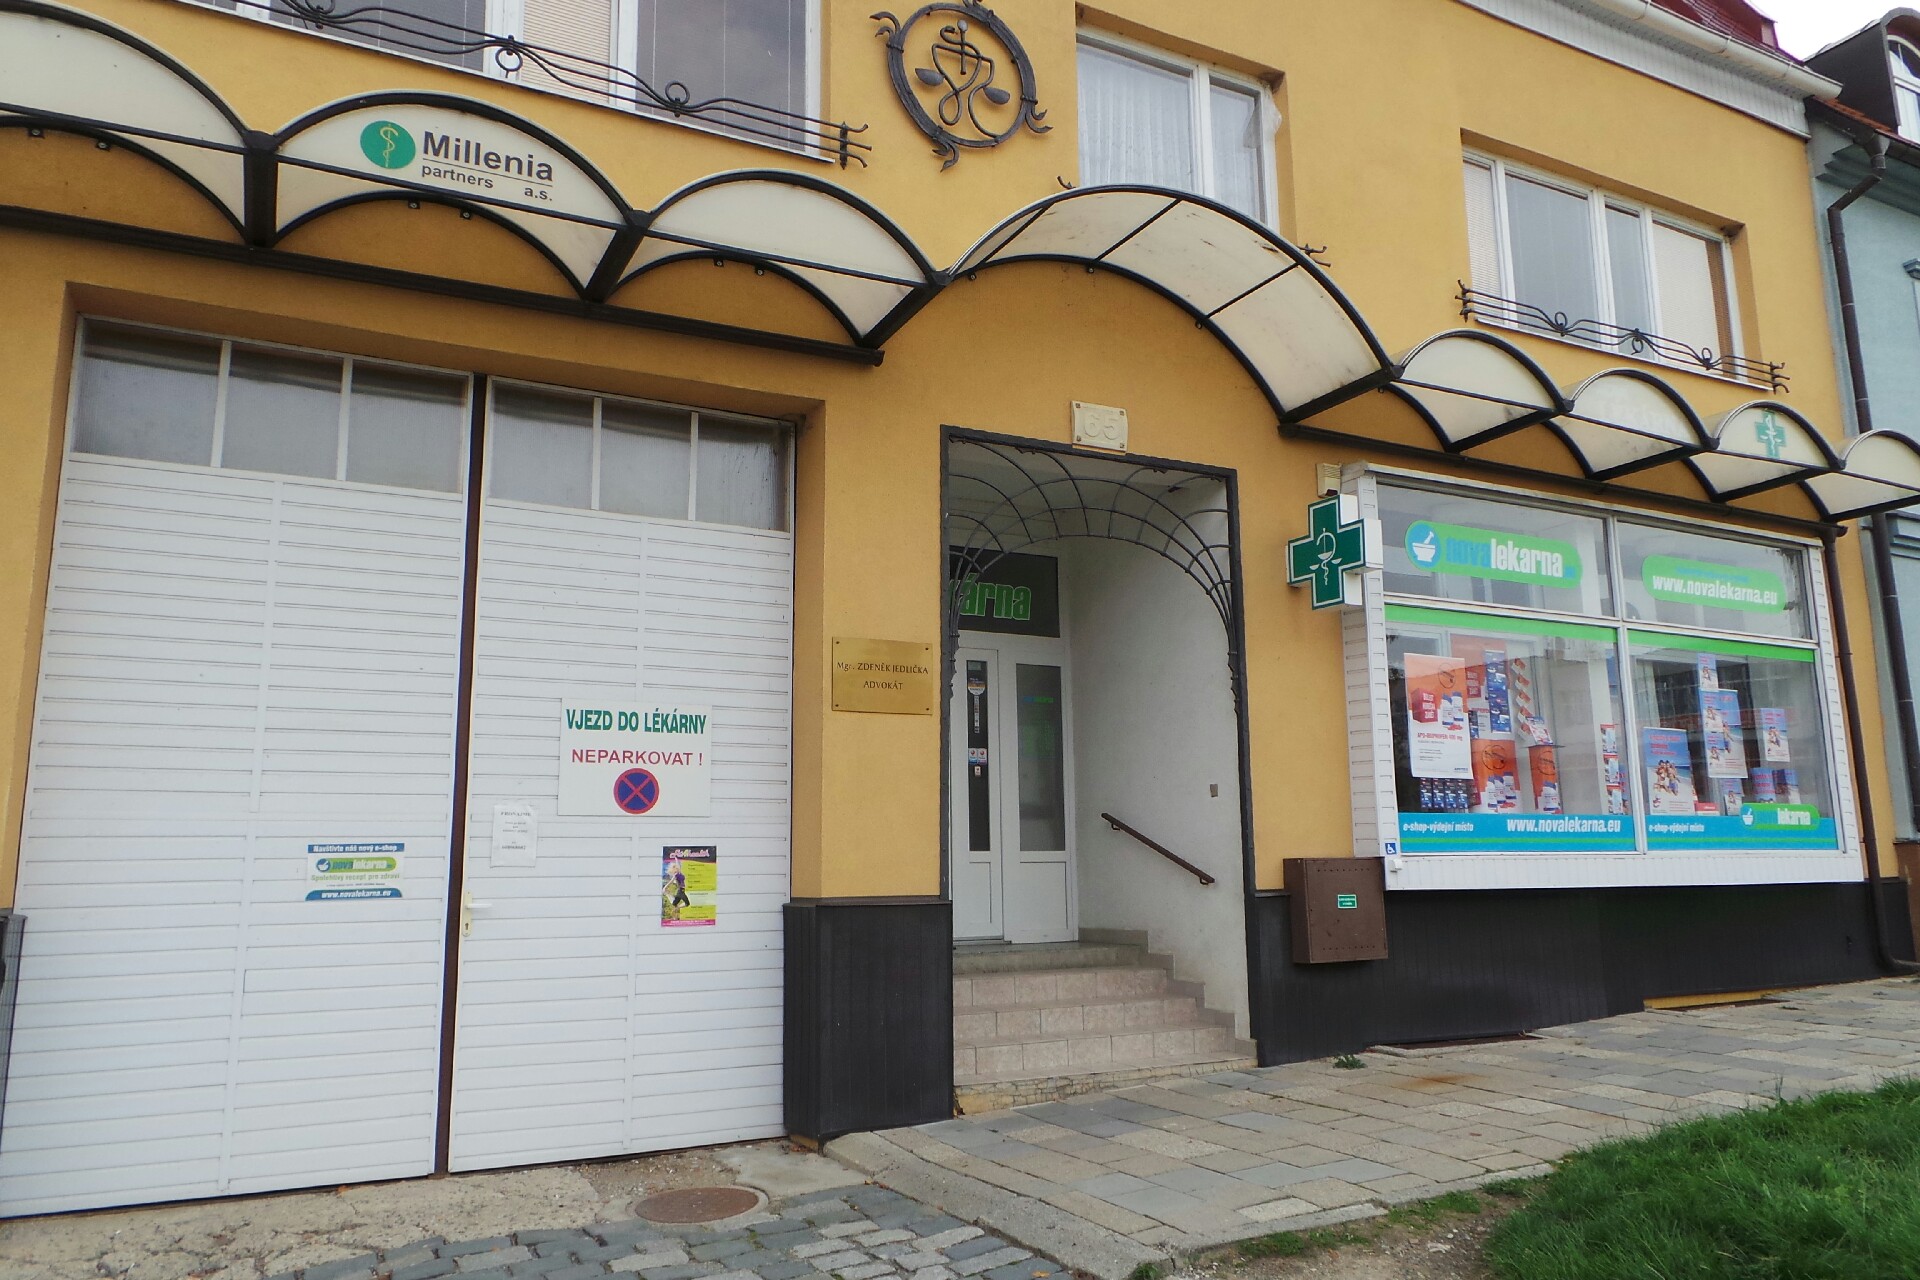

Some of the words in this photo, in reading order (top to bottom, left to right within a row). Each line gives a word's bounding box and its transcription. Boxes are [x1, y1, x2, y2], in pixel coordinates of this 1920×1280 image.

[423, 131, 553, 181] Millenia
[422, 165, 494, 188] partners
[524, 187, 553, 201] a.s.
[1084, 413, 1121, 441] 65
[1652, 575, 1778, 605] www.novalekarna.eu
[837, 662, 855, 672] Mgr.
[857, 662, 891, 672] ZDENĚK
[892, 665, 929, 674] JEDLIČKA
[863, 680, 904, 690] ADVOKÁT
[566, 708, 613, 731] VJEZD
[618, 711, 639, 732] DO
[644, 707, 707, 734] LÉKÁRNY
[572, 749, 693, 765] NEPARKOVAT
[699, 752, 703, 766] !
[1403, 821, 1454, 834] e-shop-výdejní
[1454, 821, 1474, 832] místo
[1507, 816, 1621, 833] www.novalekarna.eu
[358, 845, 374, 853] nový
[321, 890, 392, 899] www.novalekarna.eu
